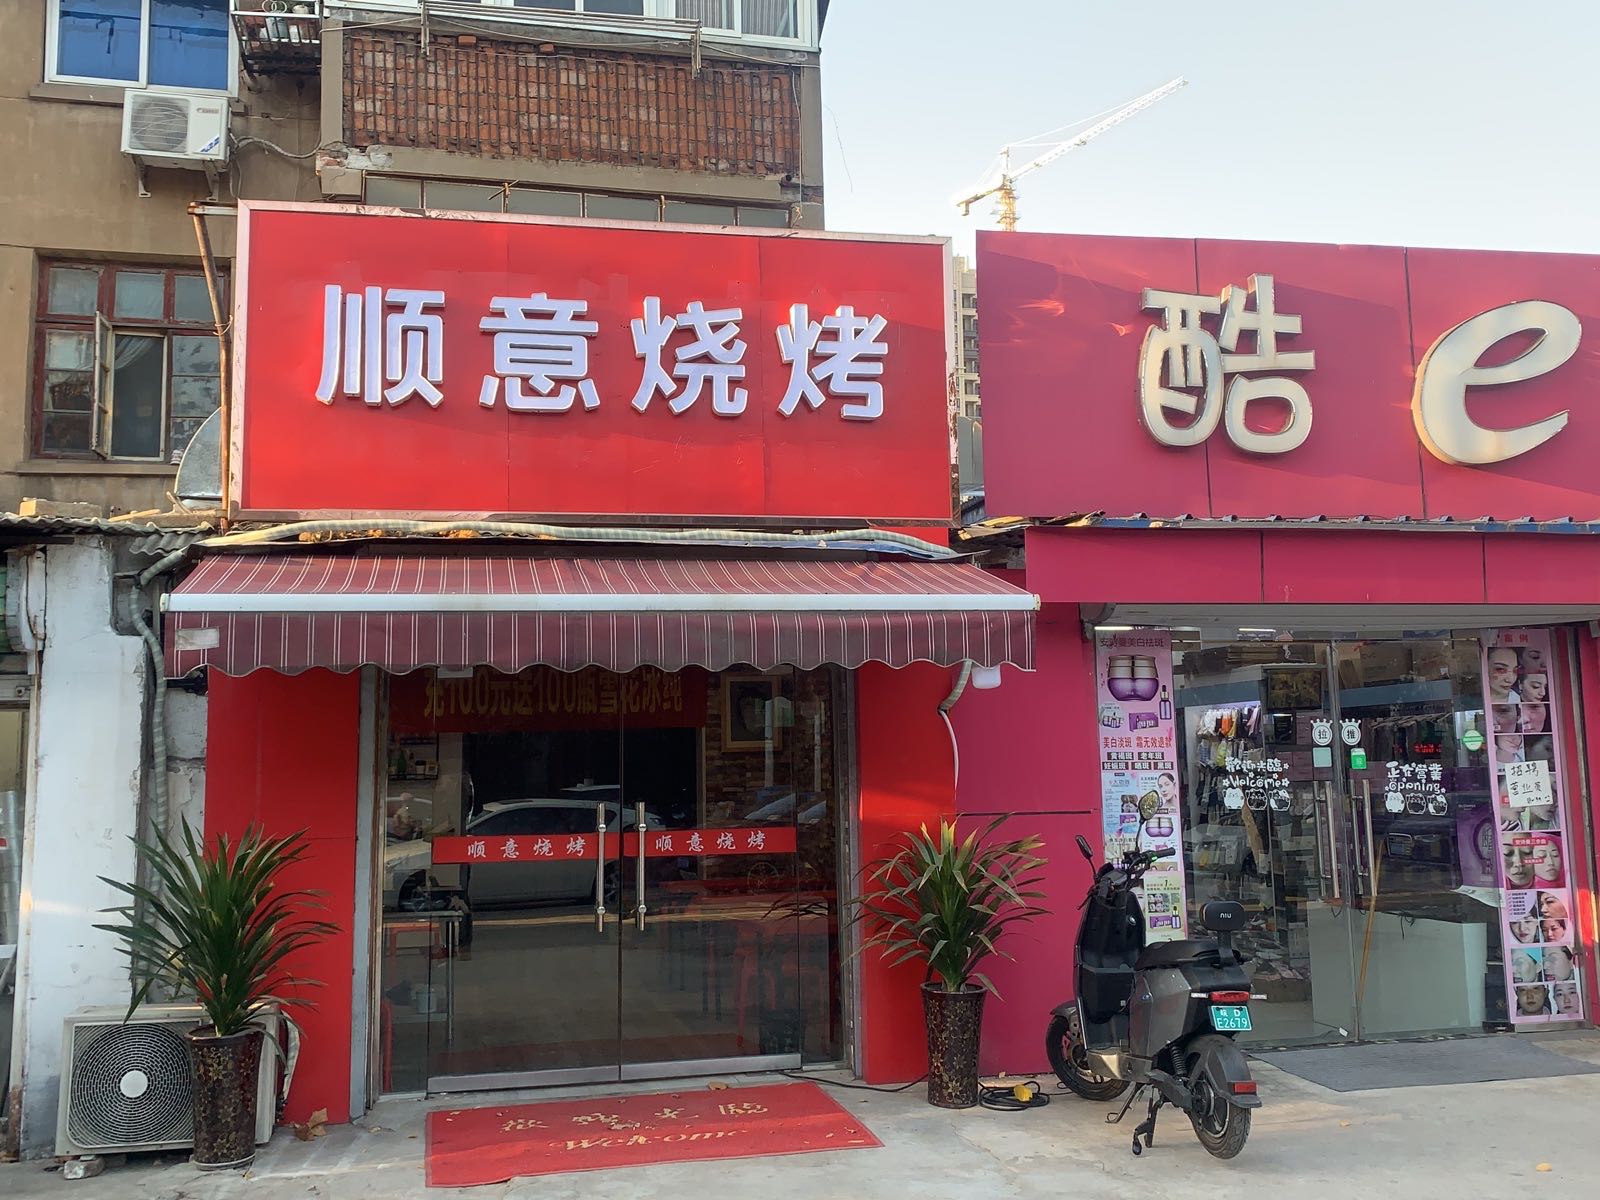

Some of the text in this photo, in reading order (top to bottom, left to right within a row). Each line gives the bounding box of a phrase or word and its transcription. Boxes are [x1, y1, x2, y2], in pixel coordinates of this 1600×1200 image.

[316, 284, 888, 420] 顺意烧烤
[1138, 273, 1583, 465] 酷 e
[1318, 729, 1328, 739] 拉
[1347, 729, 1356, 739] 推
[1140, 752, 1163, 760] 老年斑
[1511, 762, 1539, 777] 招聘
[1229, 774, 1282, 789] Welcome
[467, 835, 586, 859] 顺意烧烤
[655, 830, 766, 852] 顺意烧烤
[1217, 1018, 1247, 1028] E2679
